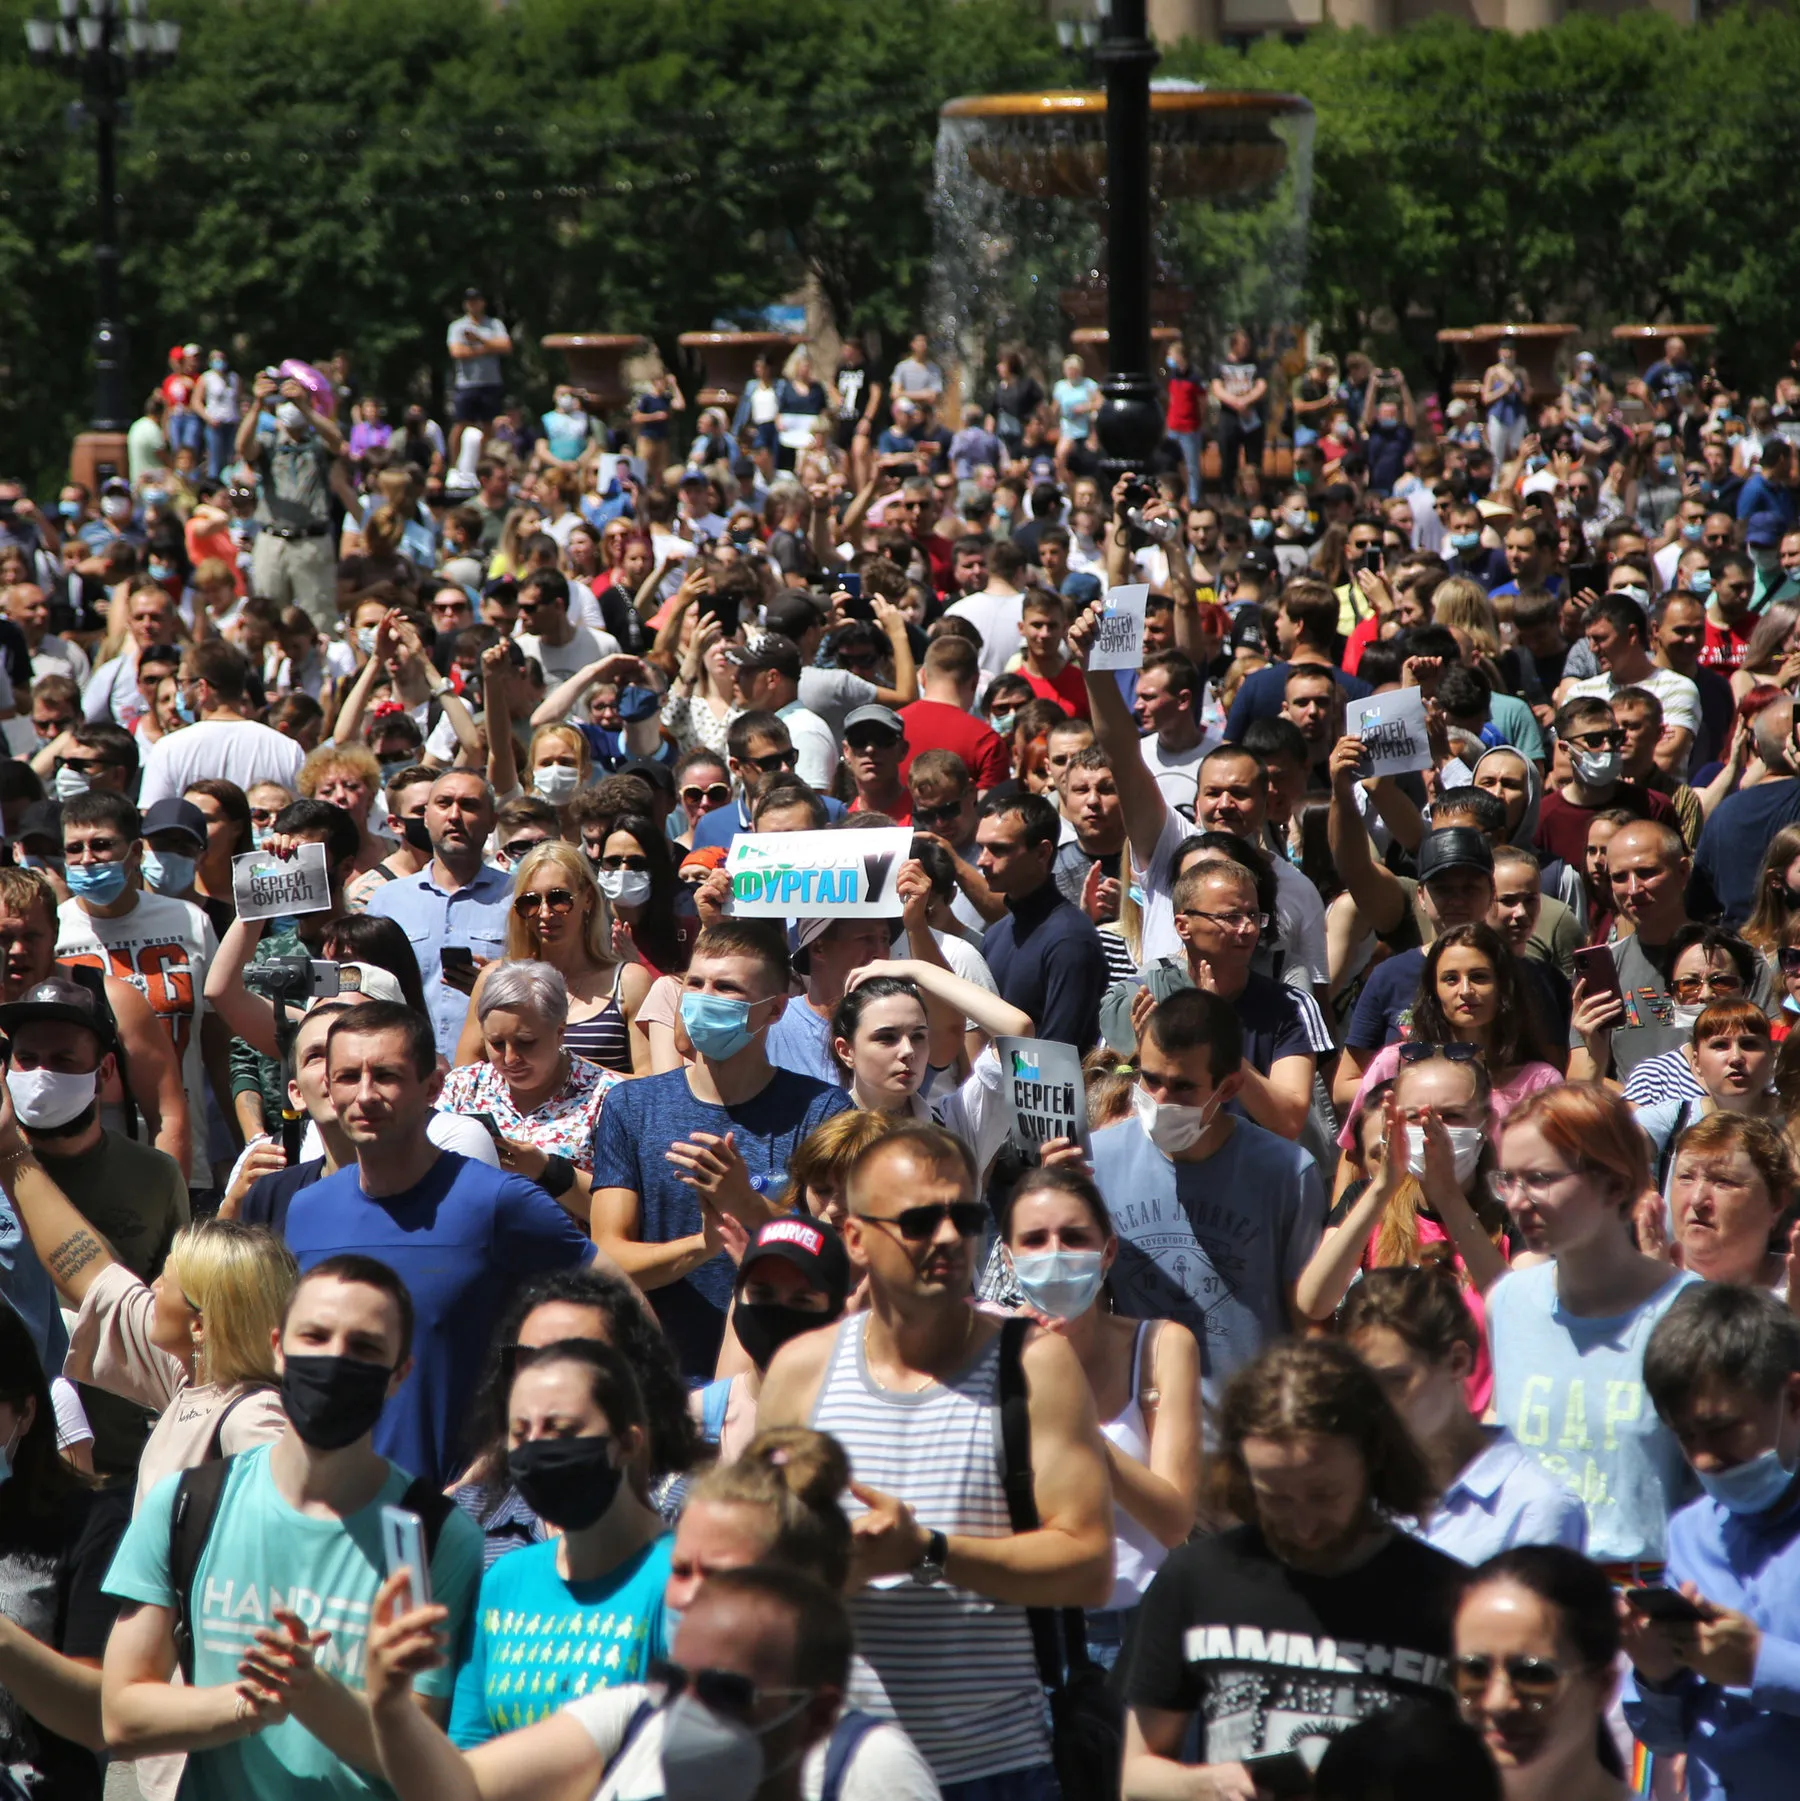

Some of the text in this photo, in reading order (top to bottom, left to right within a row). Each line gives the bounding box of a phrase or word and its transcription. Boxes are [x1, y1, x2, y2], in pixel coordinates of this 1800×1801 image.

[1100, 634, 1137, 653] ФУРГАЛ
[250, 870, 306, 893] СЕРГЕЙ
[252, 885, 314, 907] ФУРГАЛ
[115, 940, 138, 950] THE
[143, 935, 184, 945] WOODS
[1014, 1080, 1076, 1115] СЕРГЕЙ
[1114, 1199, 1162, 1233] CEAN
[762, 1223, 819, 1252] MARVEL
[1140, 1236, 1188, 1247] ADVENTURE
[1203, 1277, 1219, 1293] 37
[1517, 1375, 1642, 1451] GAP
[202, 1576, 321, 1626] HAND
